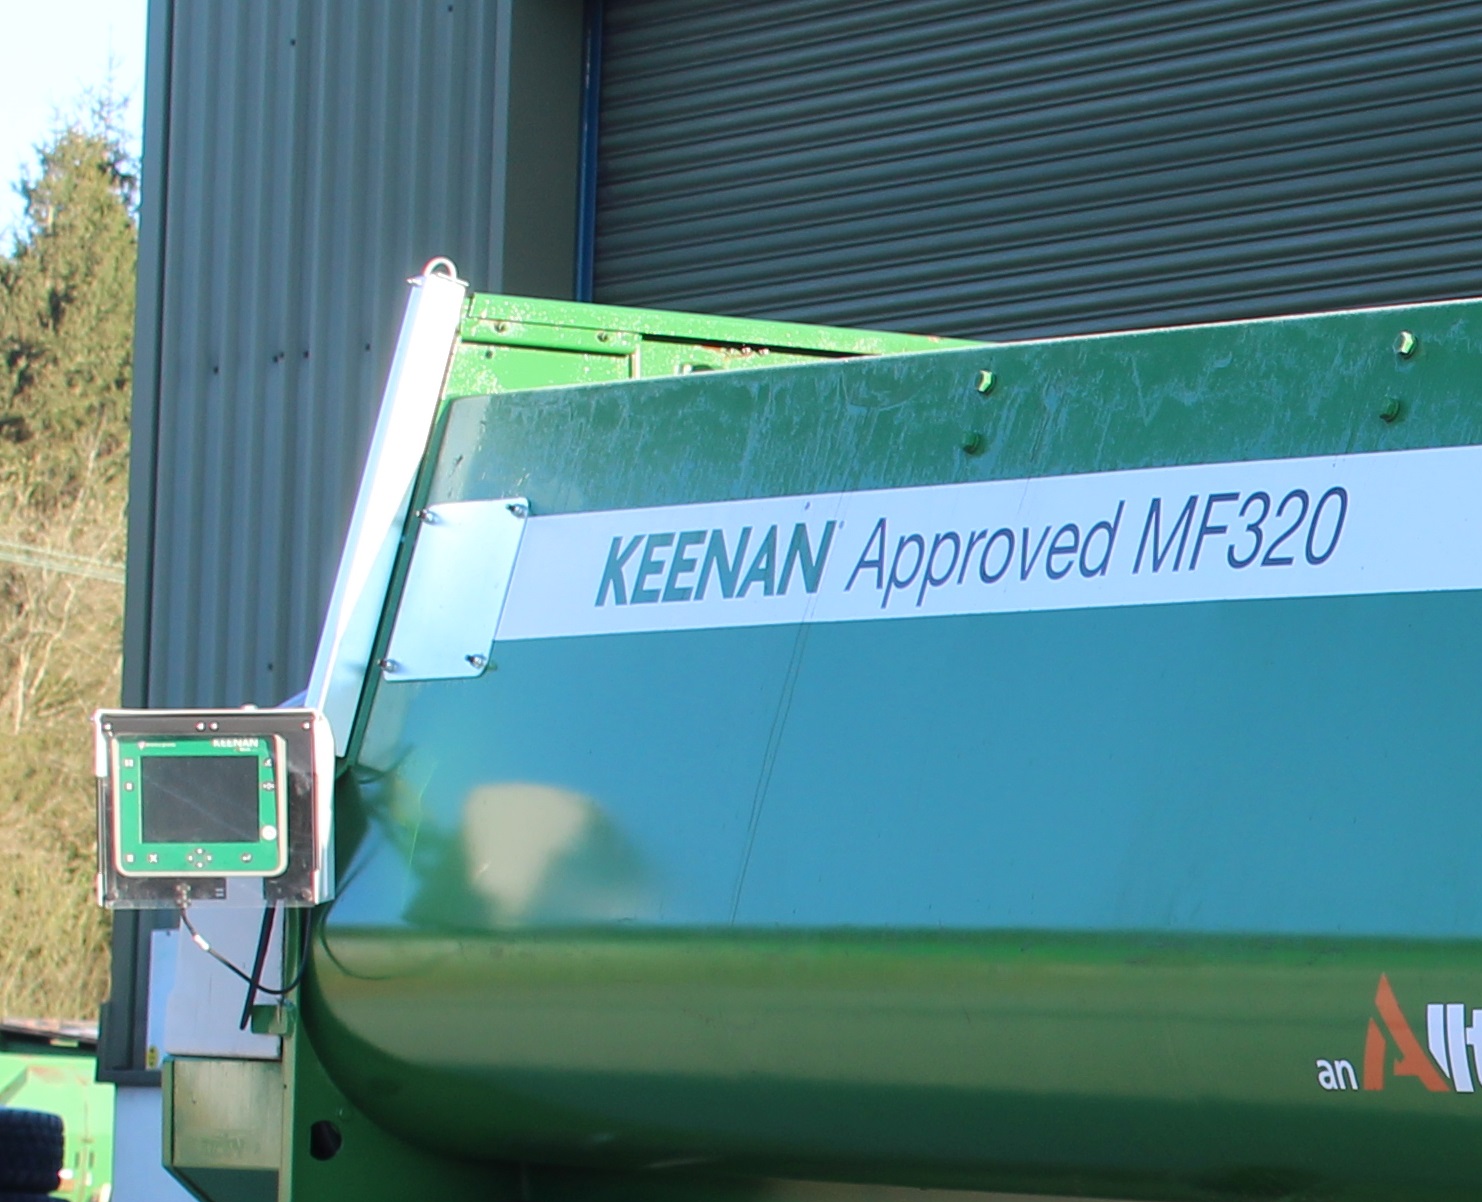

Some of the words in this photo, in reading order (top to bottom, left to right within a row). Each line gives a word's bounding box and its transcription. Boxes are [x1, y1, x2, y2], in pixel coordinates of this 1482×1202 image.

[594, 520, 838, 607] KEENAN
[844, 499, 1125, 609] Approved
[1132, 486, 1349, 574] MF320
[1315, 1058, 1359, 1091] an
